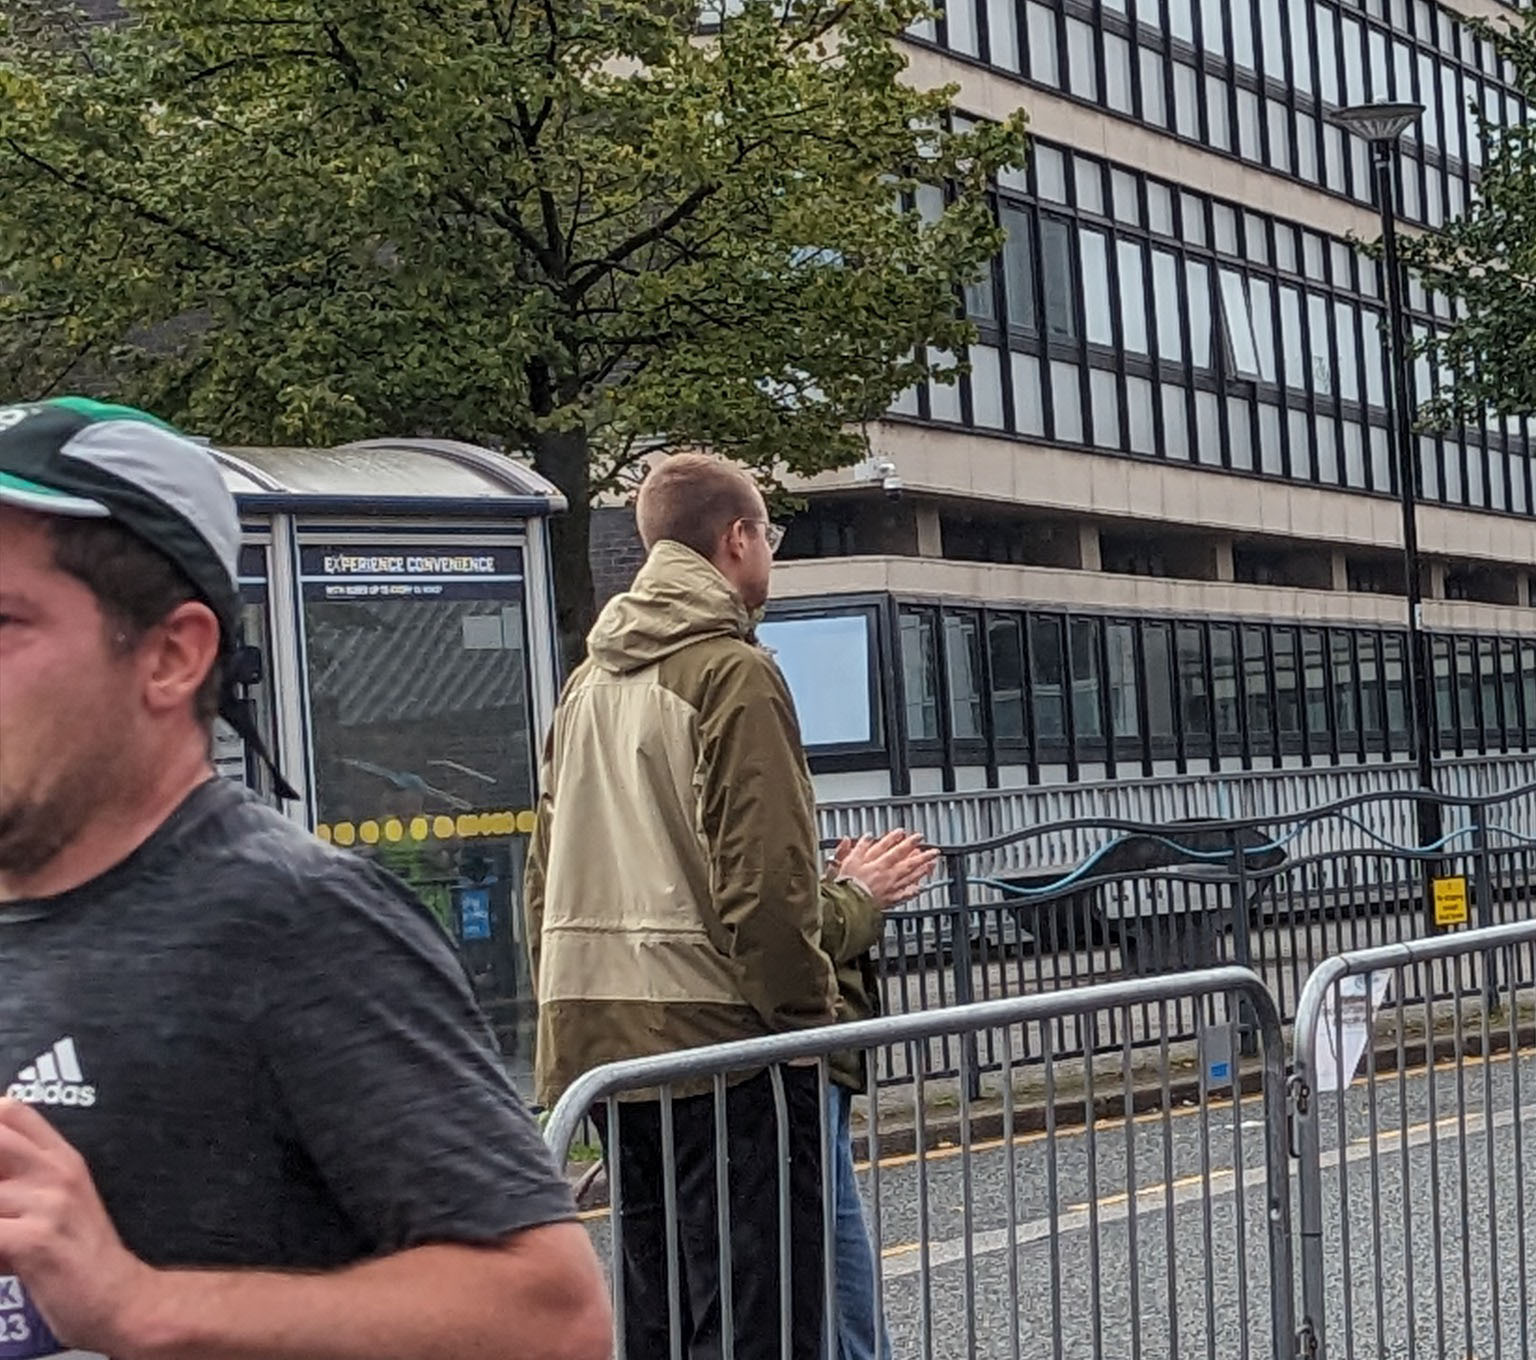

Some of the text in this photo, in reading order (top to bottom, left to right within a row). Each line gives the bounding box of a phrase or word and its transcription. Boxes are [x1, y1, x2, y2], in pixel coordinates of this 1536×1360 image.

[324, 556, 495, 573] EXPERIENCE CONVENIENCE
[7, 1080, 96, 1107] adidas
